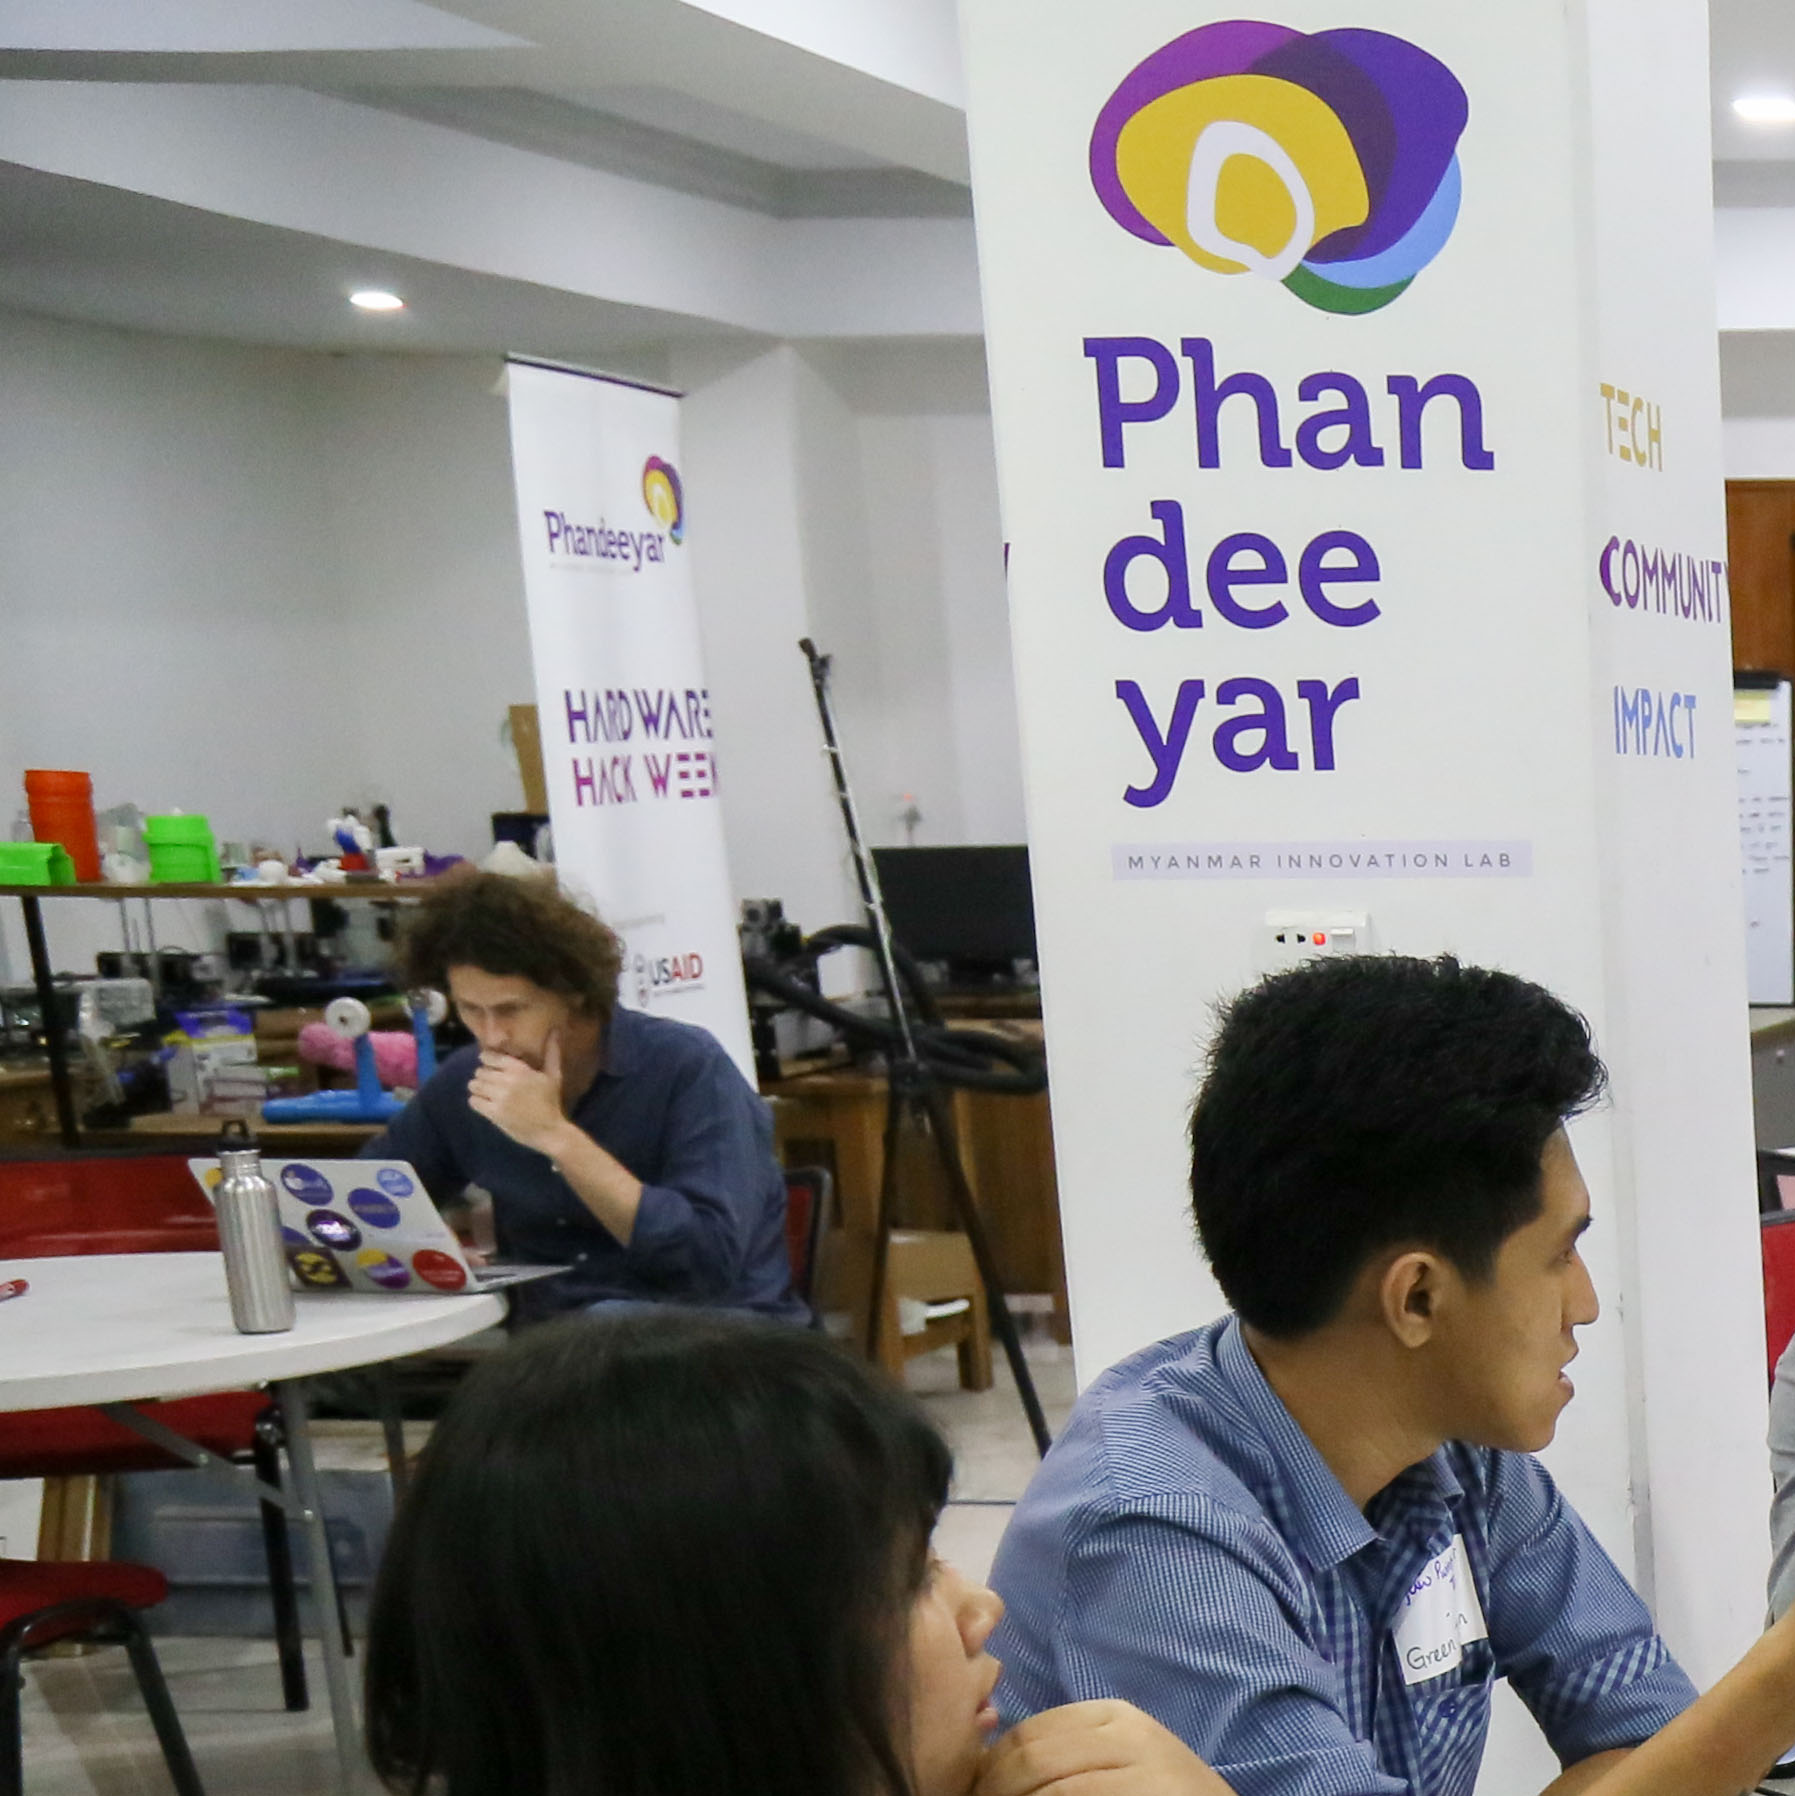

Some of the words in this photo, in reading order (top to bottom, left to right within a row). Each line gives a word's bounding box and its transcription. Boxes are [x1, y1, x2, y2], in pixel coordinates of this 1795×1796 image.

[1082, 337, 1495, 472] Phan
[1599, 382, 1663, 473] TECH
[543, 510, 666, 573] Phandeeyar
[1102, 500, 1382, 632] dee
[1114, 676, 1361, 809] yar
[1613, 685, 1698, 760] IMPACT
[572, 755, 638, 807] HACK
[1127, 853, 1263, 870] MYANMAR
[1277, 853, 1450, 869] INNOVATION
[1464, 853, 1513, 869] LAB
[651, 952, 704, 986] USAID
[1406, 1638, 1457, 1671] Green
